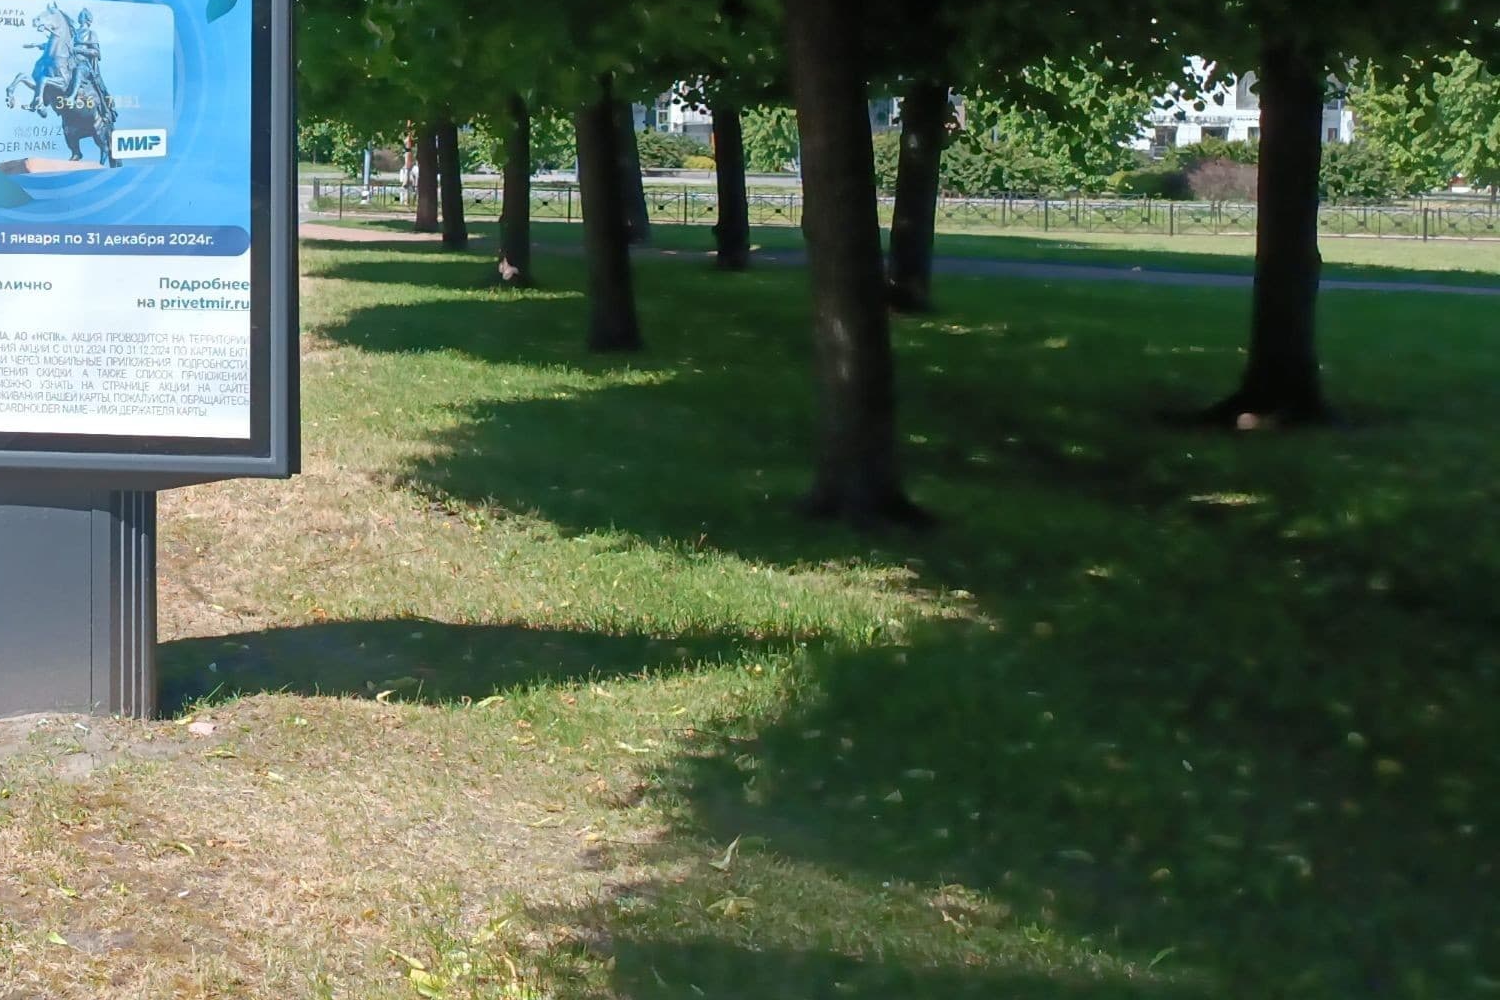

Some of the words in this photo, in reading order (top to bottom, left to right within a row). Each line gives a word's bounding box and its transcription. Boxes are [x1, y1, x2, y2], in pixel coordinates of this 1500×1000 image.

[24, 141, 58, 152] NAME
[117, 136, 161, 152] МИР
[0, 232, 6, 243] 1
[10, 234, 60, 246] января
[65, 234, 82, 244] по
[86, 233, 100, 244] 31
[104, 233, 165, 246] декабря
[169, 234, 214, 245] 2024г.
[159, 277, 250, 292] Подробнее
[137, 298, 156, 308] на
[161, 297, 250, 311] privetmir.ru
